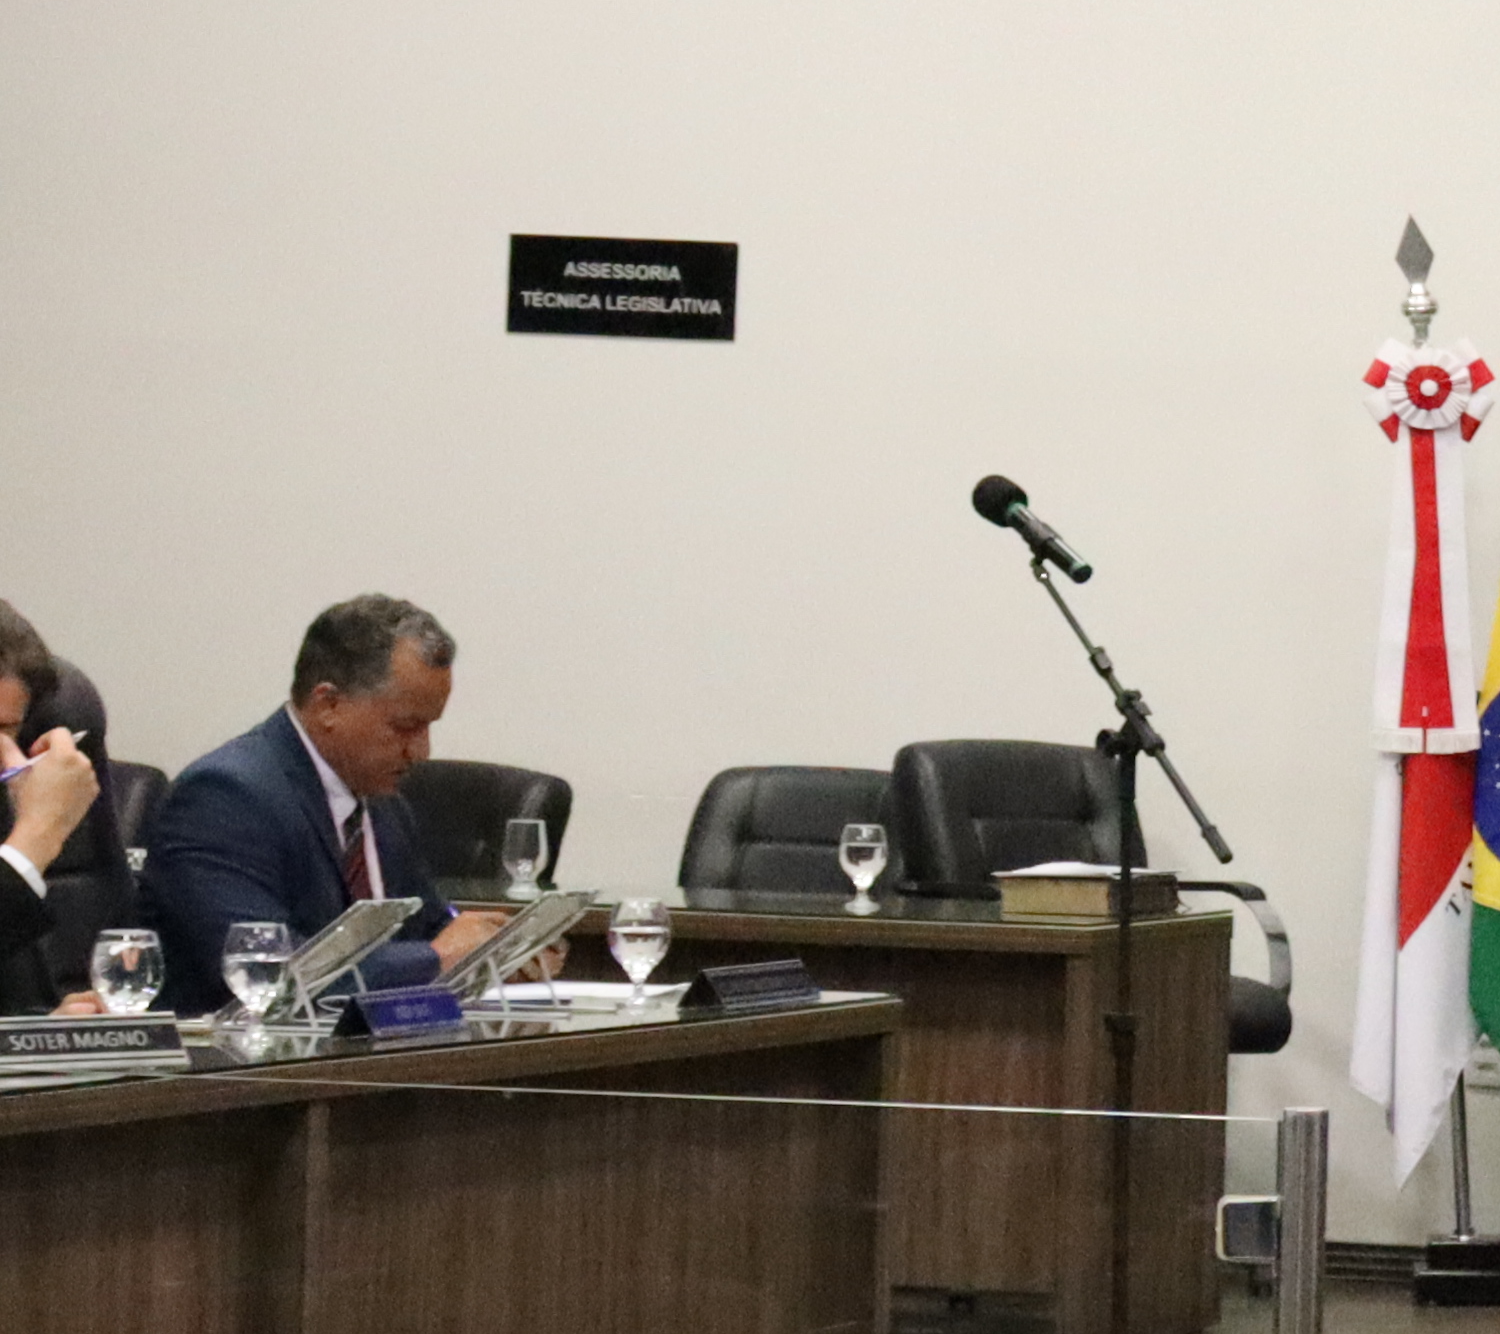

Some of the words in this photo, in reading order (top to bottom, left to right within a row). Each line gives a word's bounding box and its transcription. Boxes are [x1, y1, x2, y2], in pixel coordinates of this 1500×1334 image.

[564, 261, 681, 281] ASSESSORIA
[520, 288, 600, 310] TÉCNICA
[605, 295, 722, 315] LEGISLATIVA
[9, 1033, 69, 1050] SOTER
[72, 1030, 147, 1048] MAGNO
